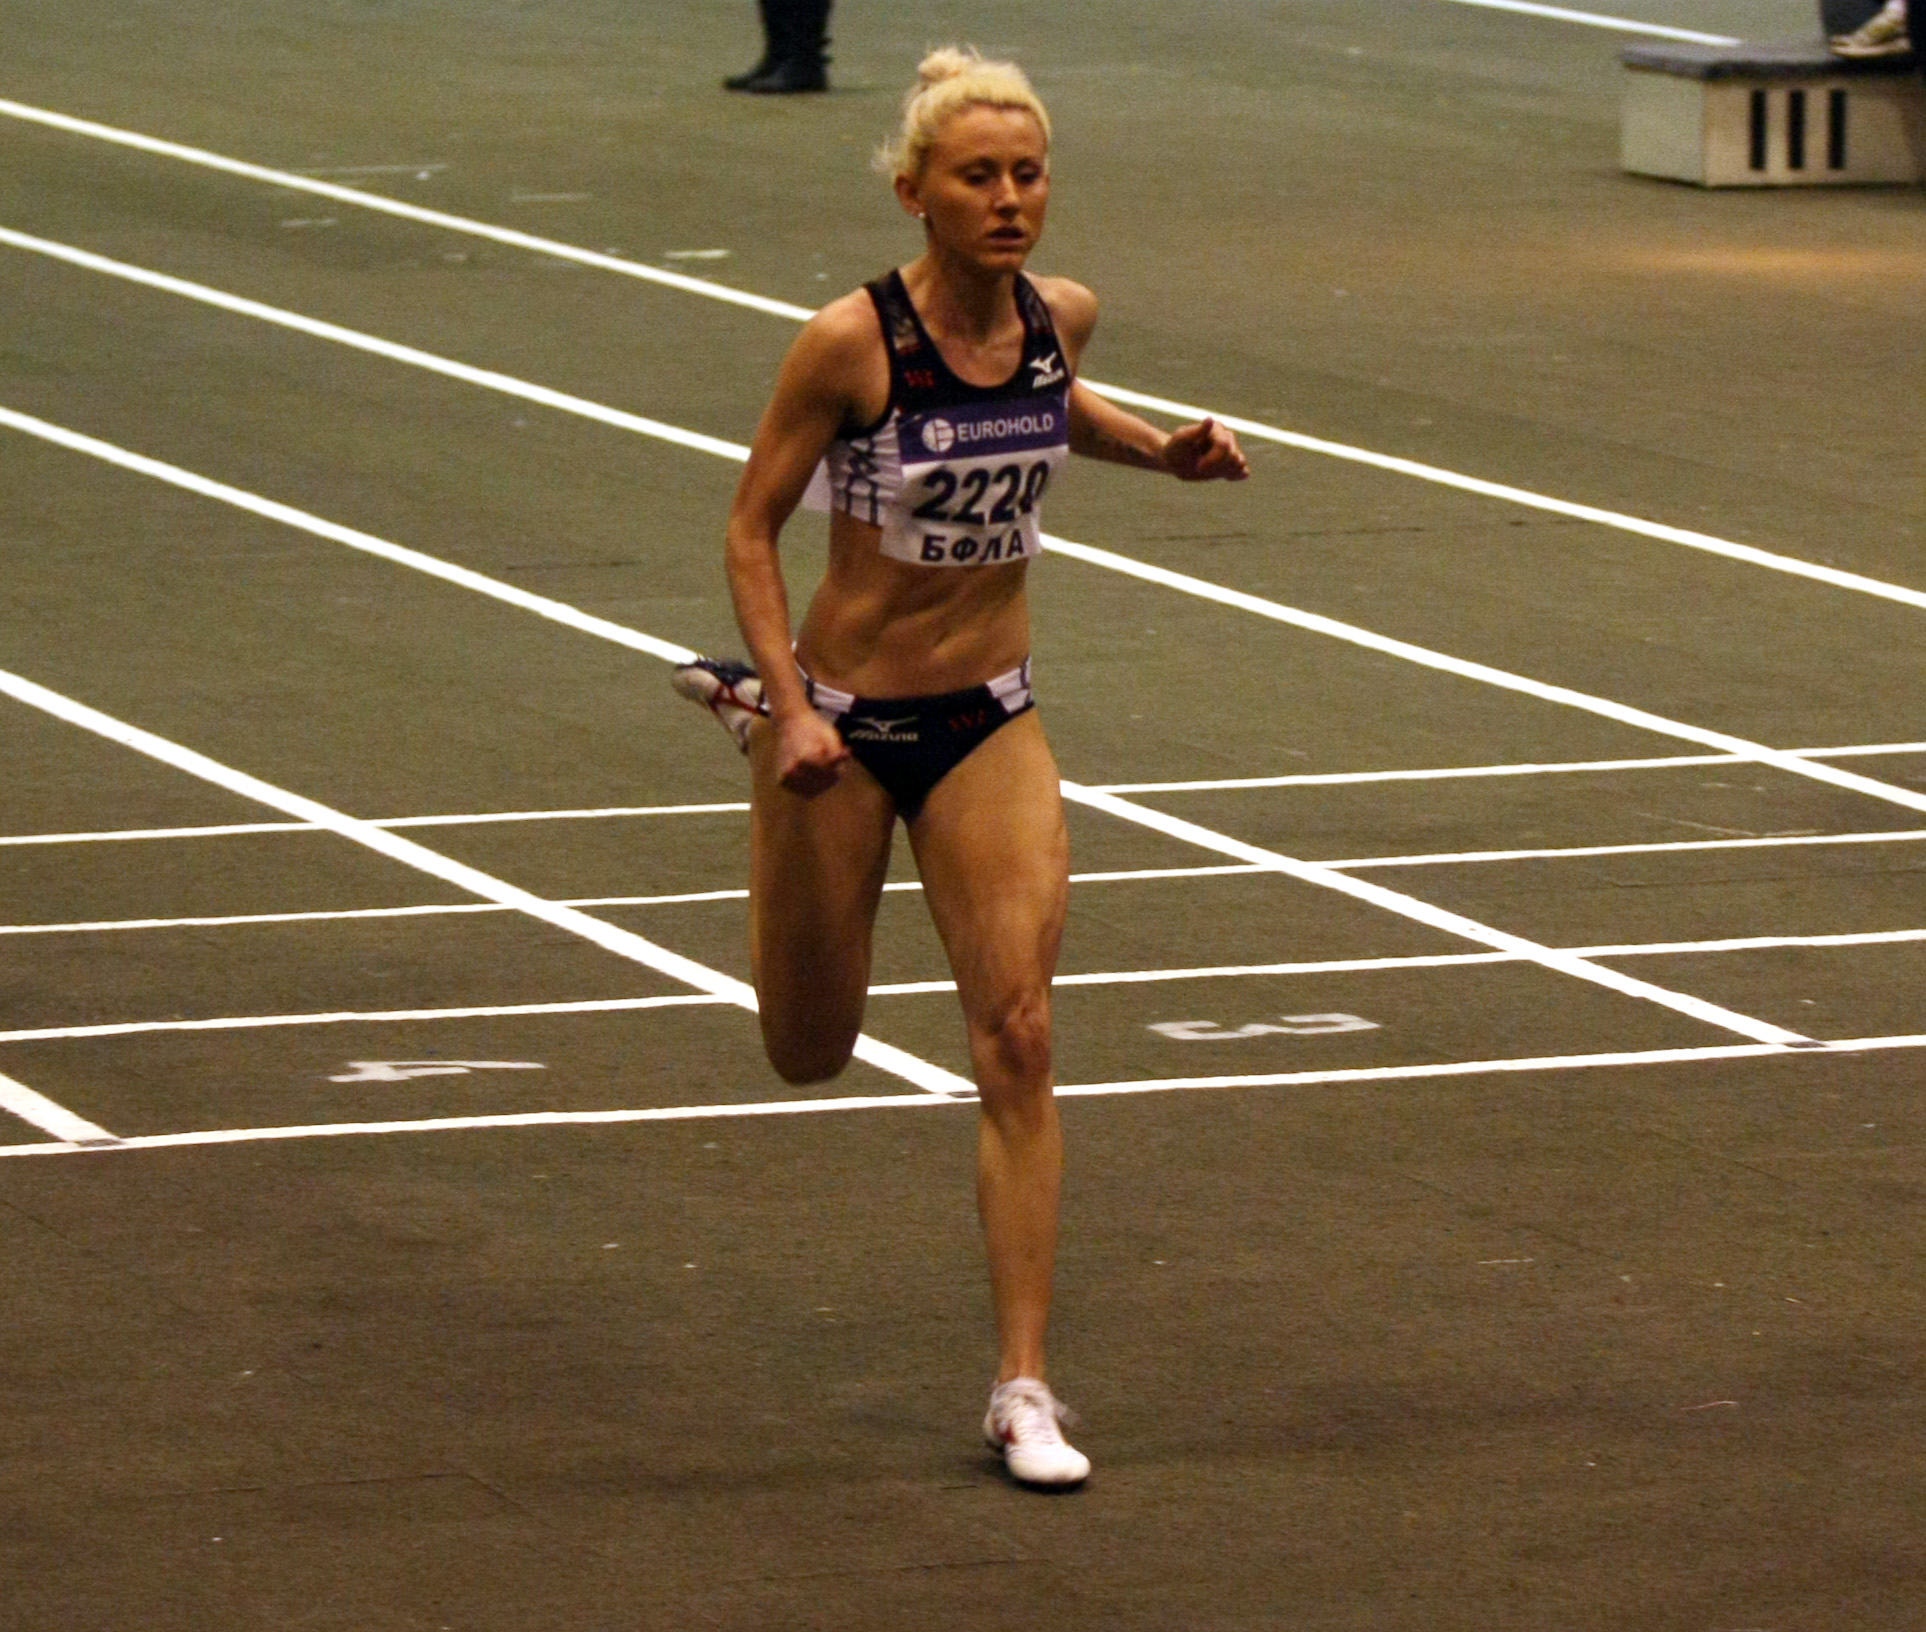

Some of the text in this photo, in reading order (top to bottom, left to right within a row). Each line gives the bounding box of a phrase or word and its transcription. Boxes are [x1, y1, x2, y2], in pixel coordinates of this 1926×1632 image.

[957, 413, 1054, 442] EUROHOLD
[921, 528, 1025, 562] БФЛА
[328, 1060, 548, 1083] 4
